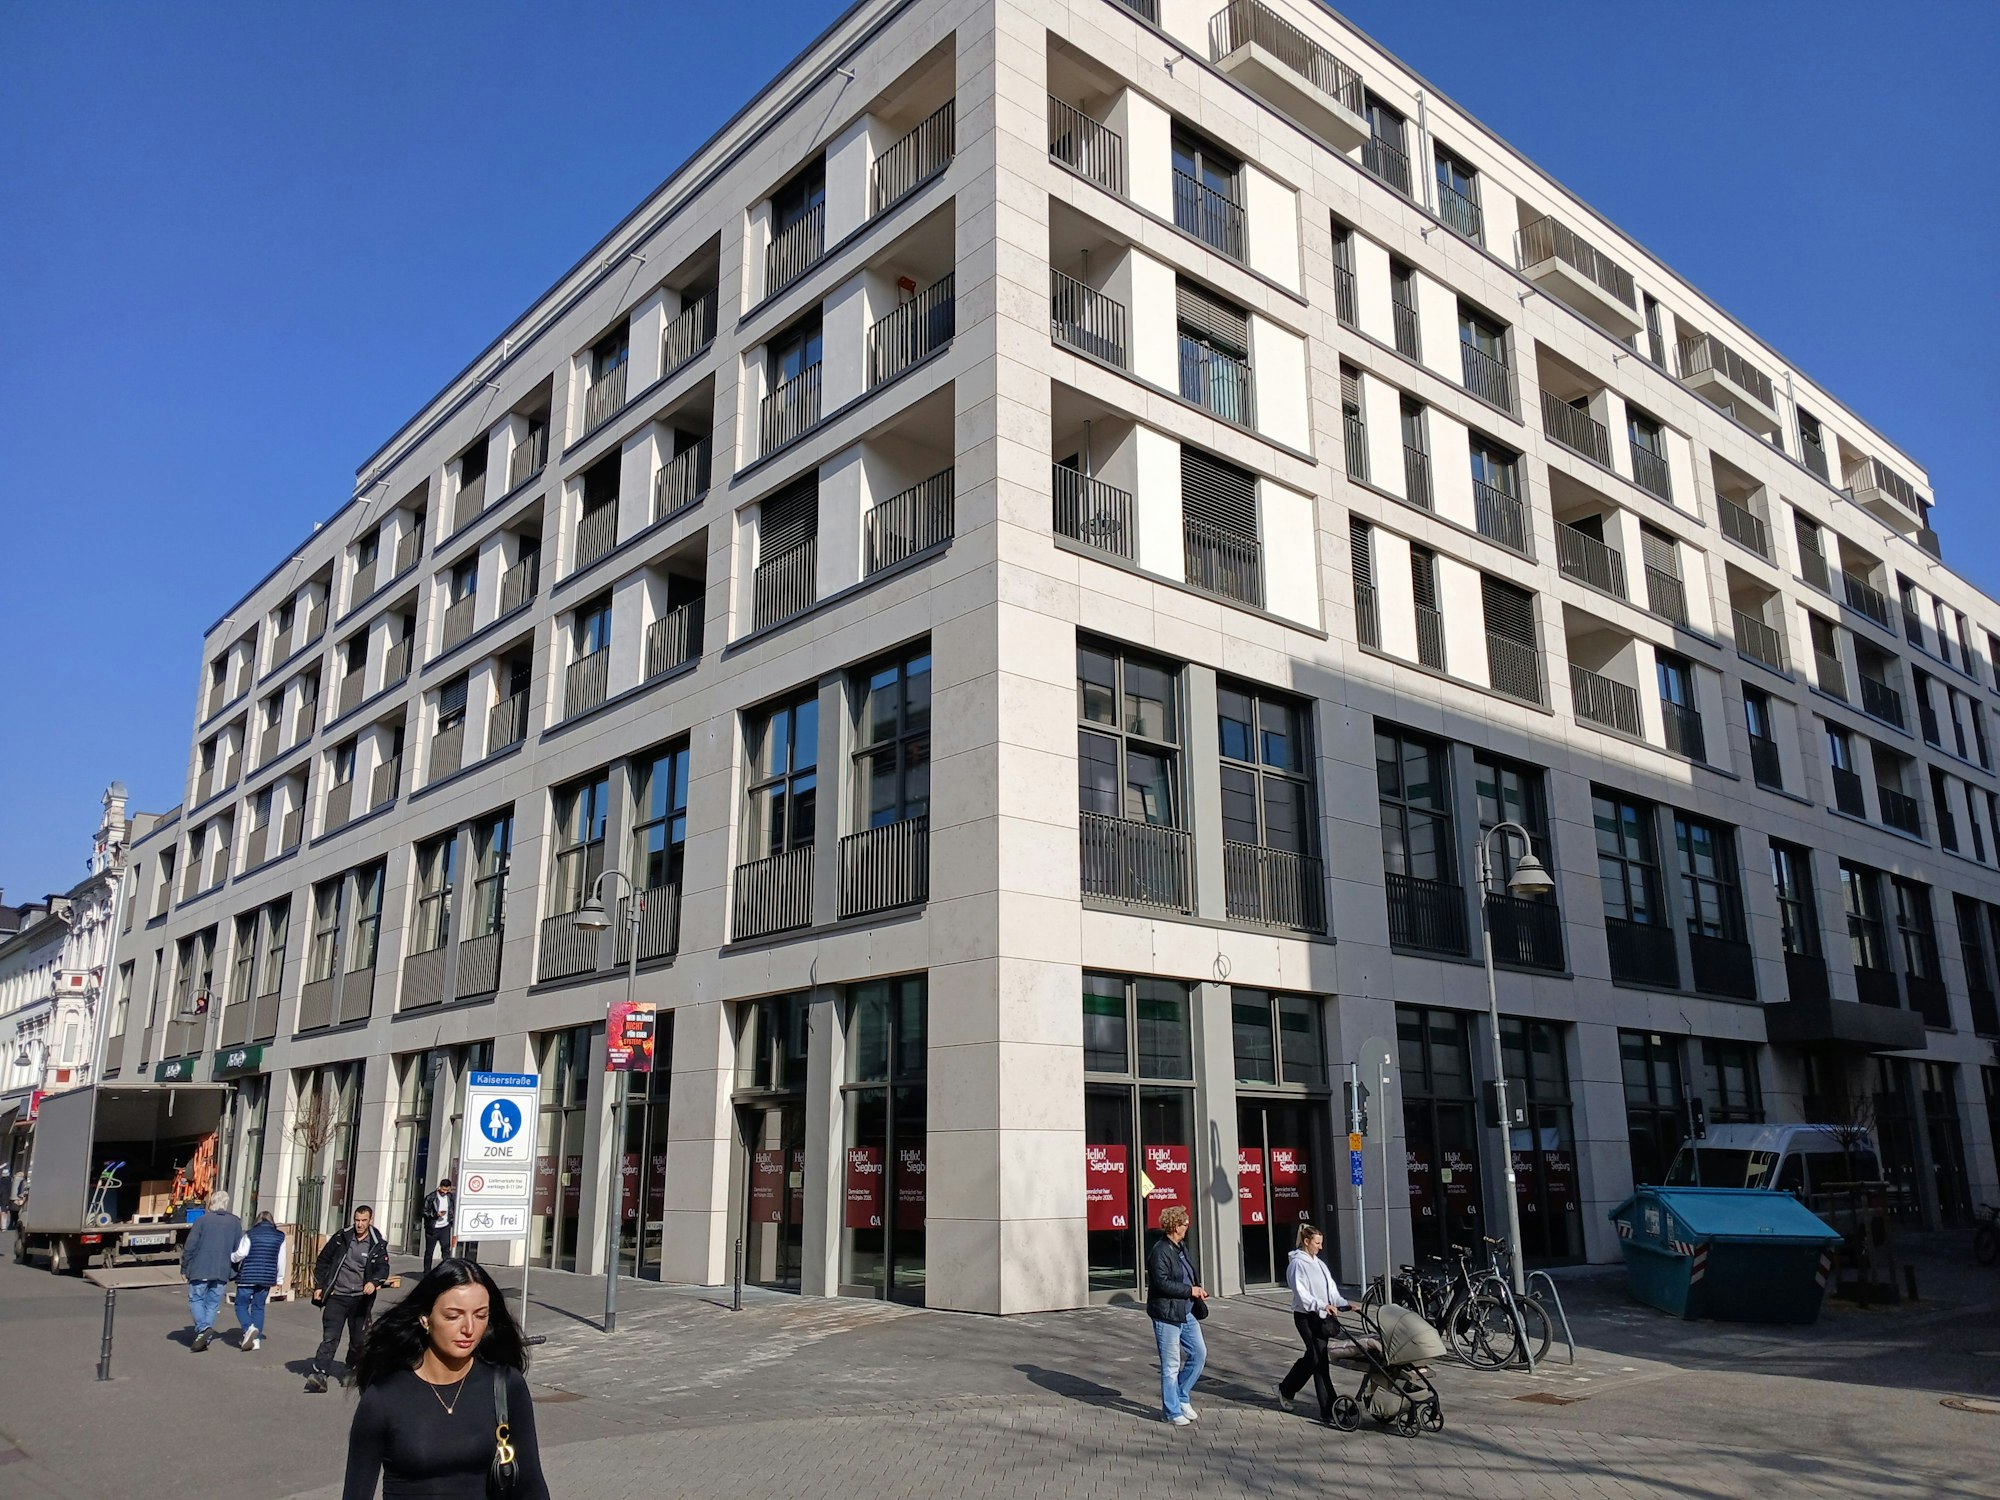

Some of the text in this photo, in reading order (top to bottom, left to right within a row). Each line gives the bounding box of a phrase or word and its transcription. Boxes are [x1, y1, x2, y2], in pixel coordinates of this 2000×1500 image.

[626, 1022, 643, 1030] NICHT
[477, 1075, 531, 1085] Kaiserstraße
[484, 1147, 513, 1157] ZONE
[849, 1151, 868, 1162] Hello!
[900, 1150, 920, 1161] Hello!
[1148, 1149, 1170, 1160] Hello!
[1273, 1152, 1292, 1162] Hello!
[760, 1162, 783, 1174] Siegburg
[855, 1161, 882, 1174] Siegburg
[1090, 1160, 1124, 1173] Siegburg
[1156, 1160, 1187, 1173] Siegburg
[1280, 1161, 1306, 1173] Siegburg
[1451, 1161, 1472, 1172] Siegburg
[500, 1214, 518, 1226] frei
